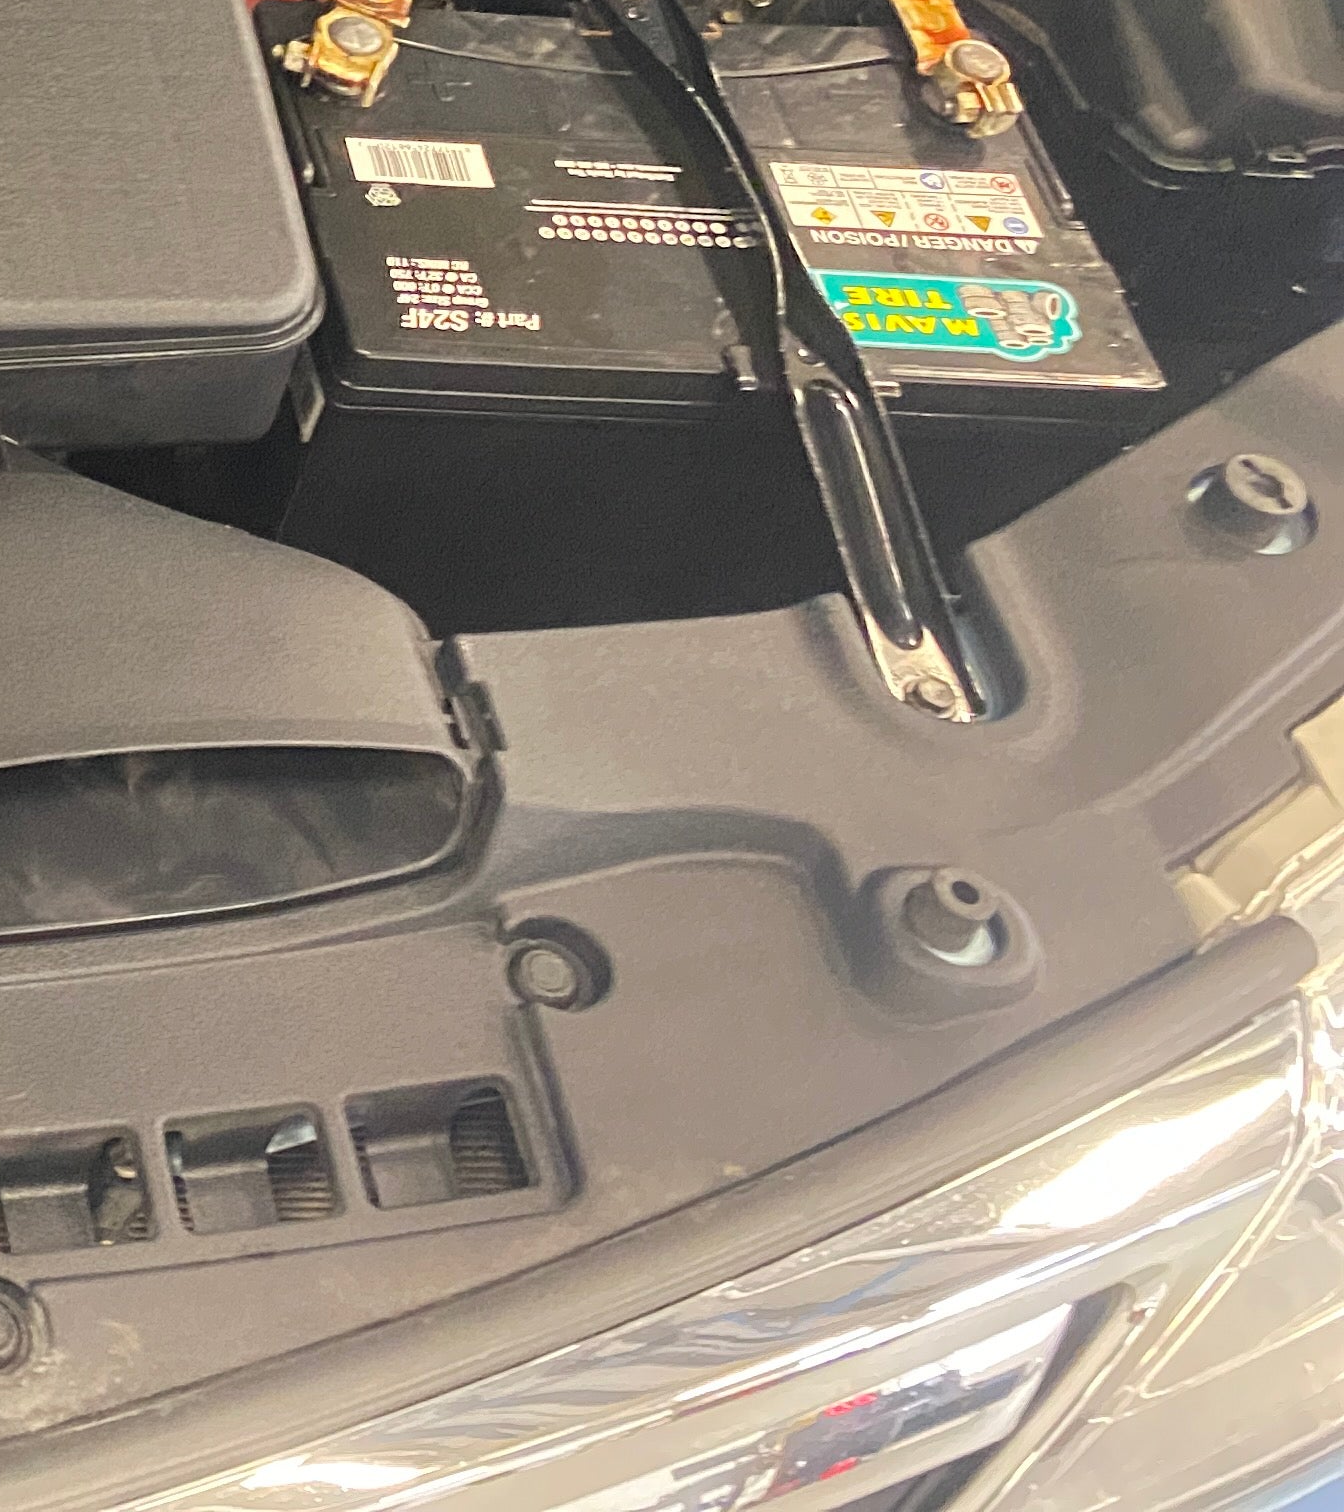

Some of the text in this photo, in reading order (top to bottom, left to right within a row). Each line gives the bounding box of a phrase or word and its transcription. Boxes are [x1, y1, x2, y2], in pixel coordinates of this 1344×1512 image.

[912, 234, 1013, 255] DANGER
[841, 285, 953, 310] TIRE
[400, 307, 470, 332] S24F
[497, 311, 541, 331] Part
[841, 312, 980, 337] MAVIS
